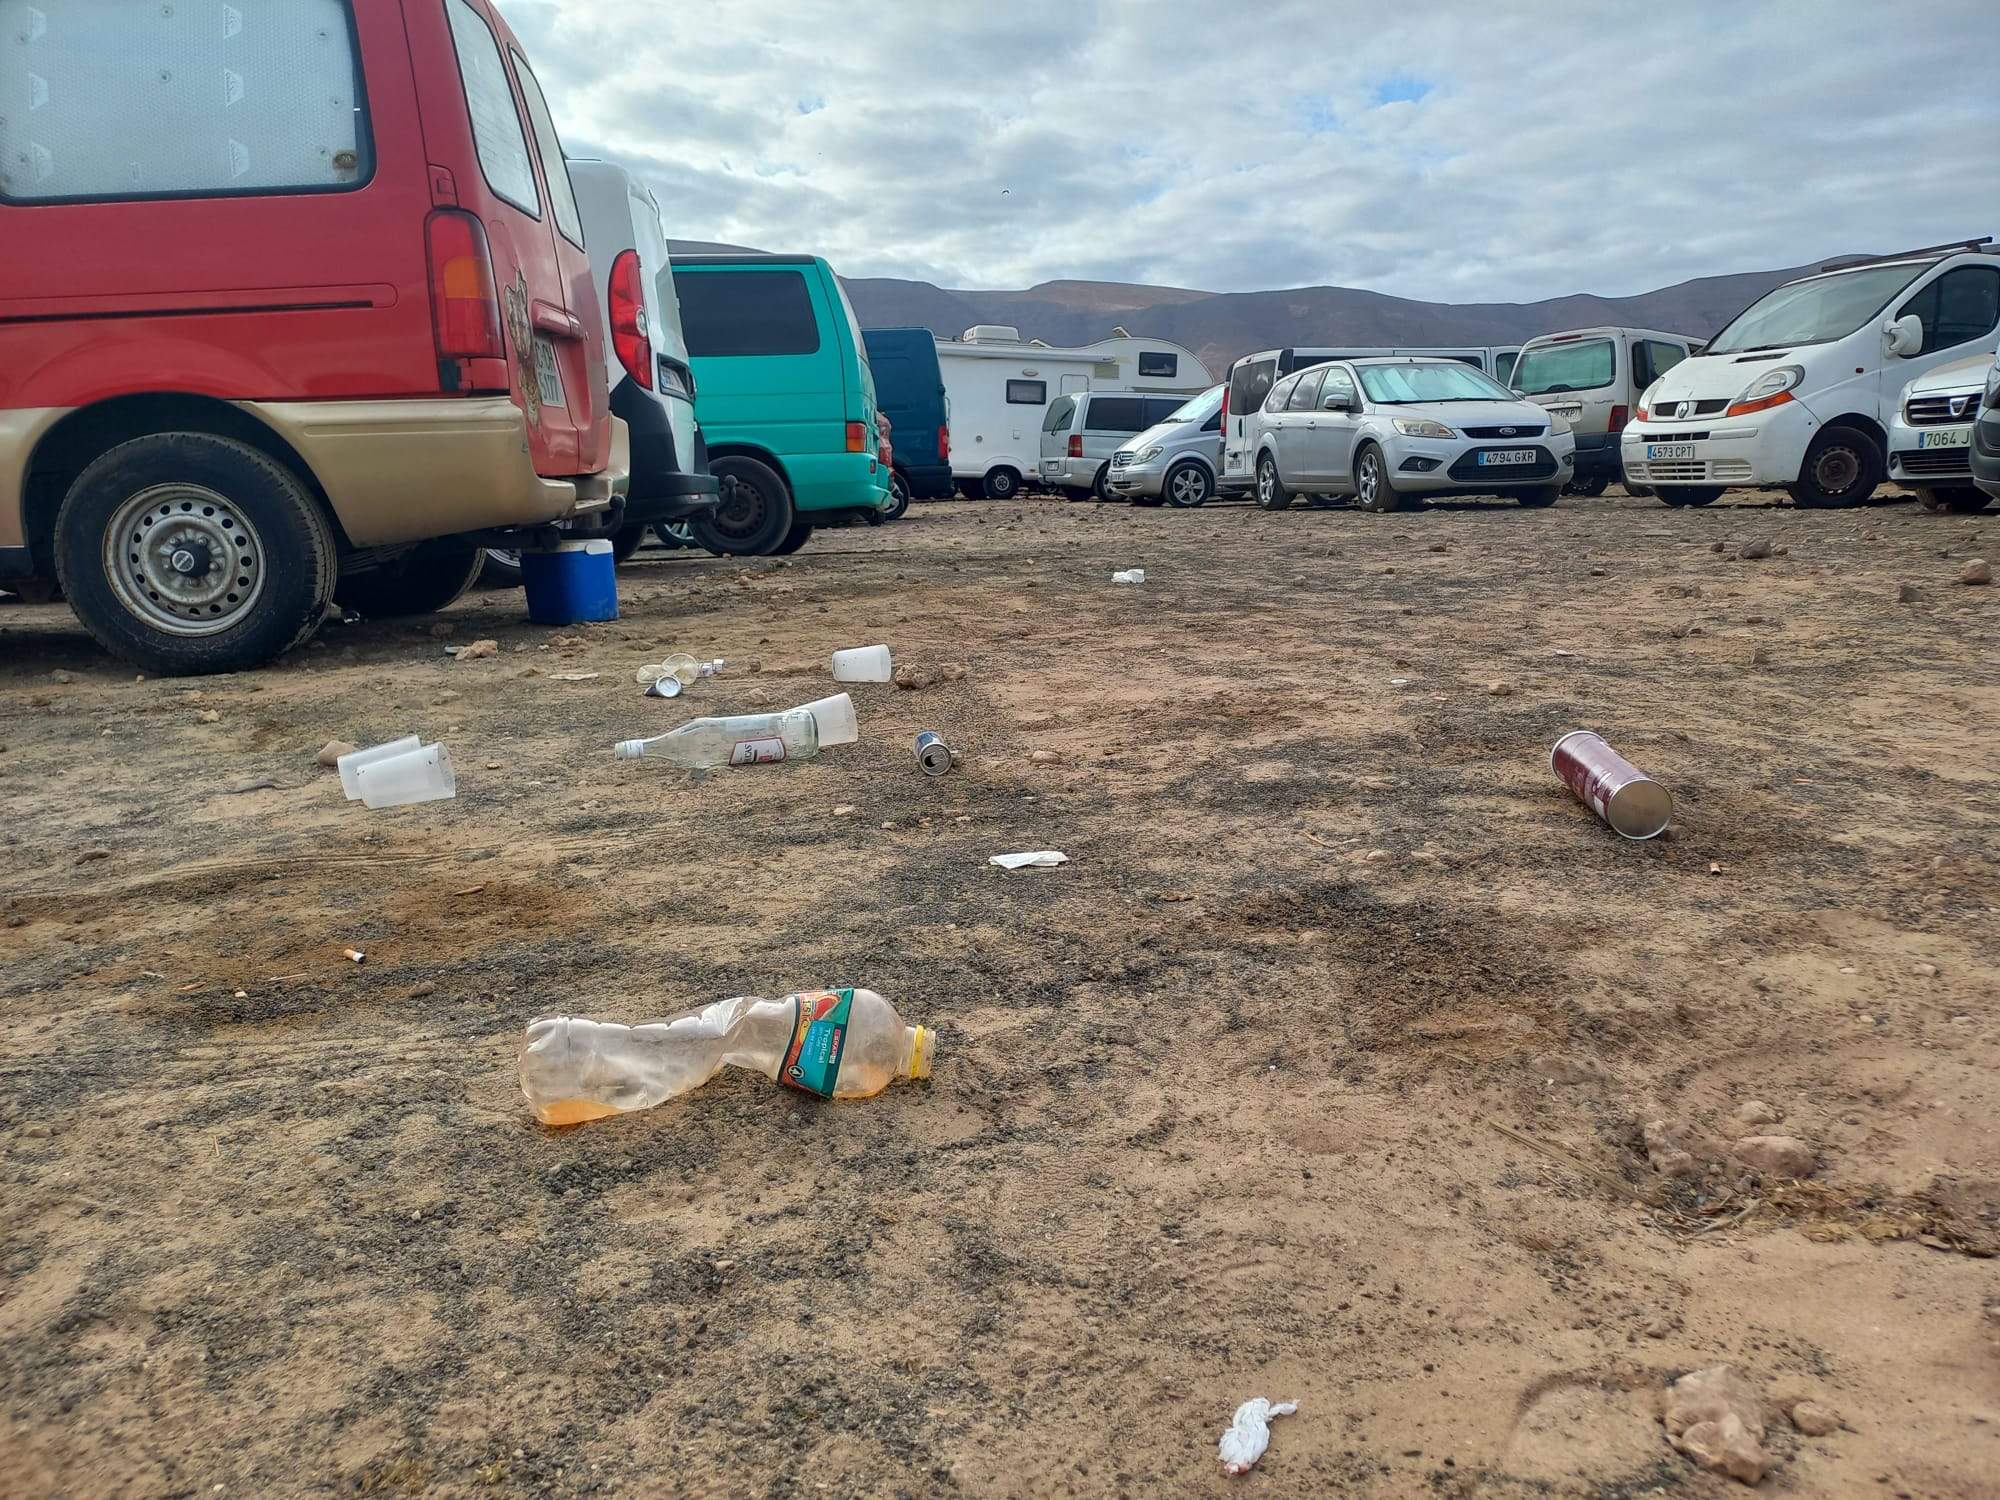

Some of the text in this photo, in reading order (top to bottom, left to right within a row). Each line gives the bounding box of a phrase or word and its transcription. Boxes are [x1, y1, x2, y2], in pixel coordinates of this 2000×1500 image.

[1926, 431, 1957, 447] 7064
[1486, 451, 1534, 464] 4794 GXR
[1652, 446, 1692, 458] 4573 CPT
[817, 1028, 831, 1064] Tropical
